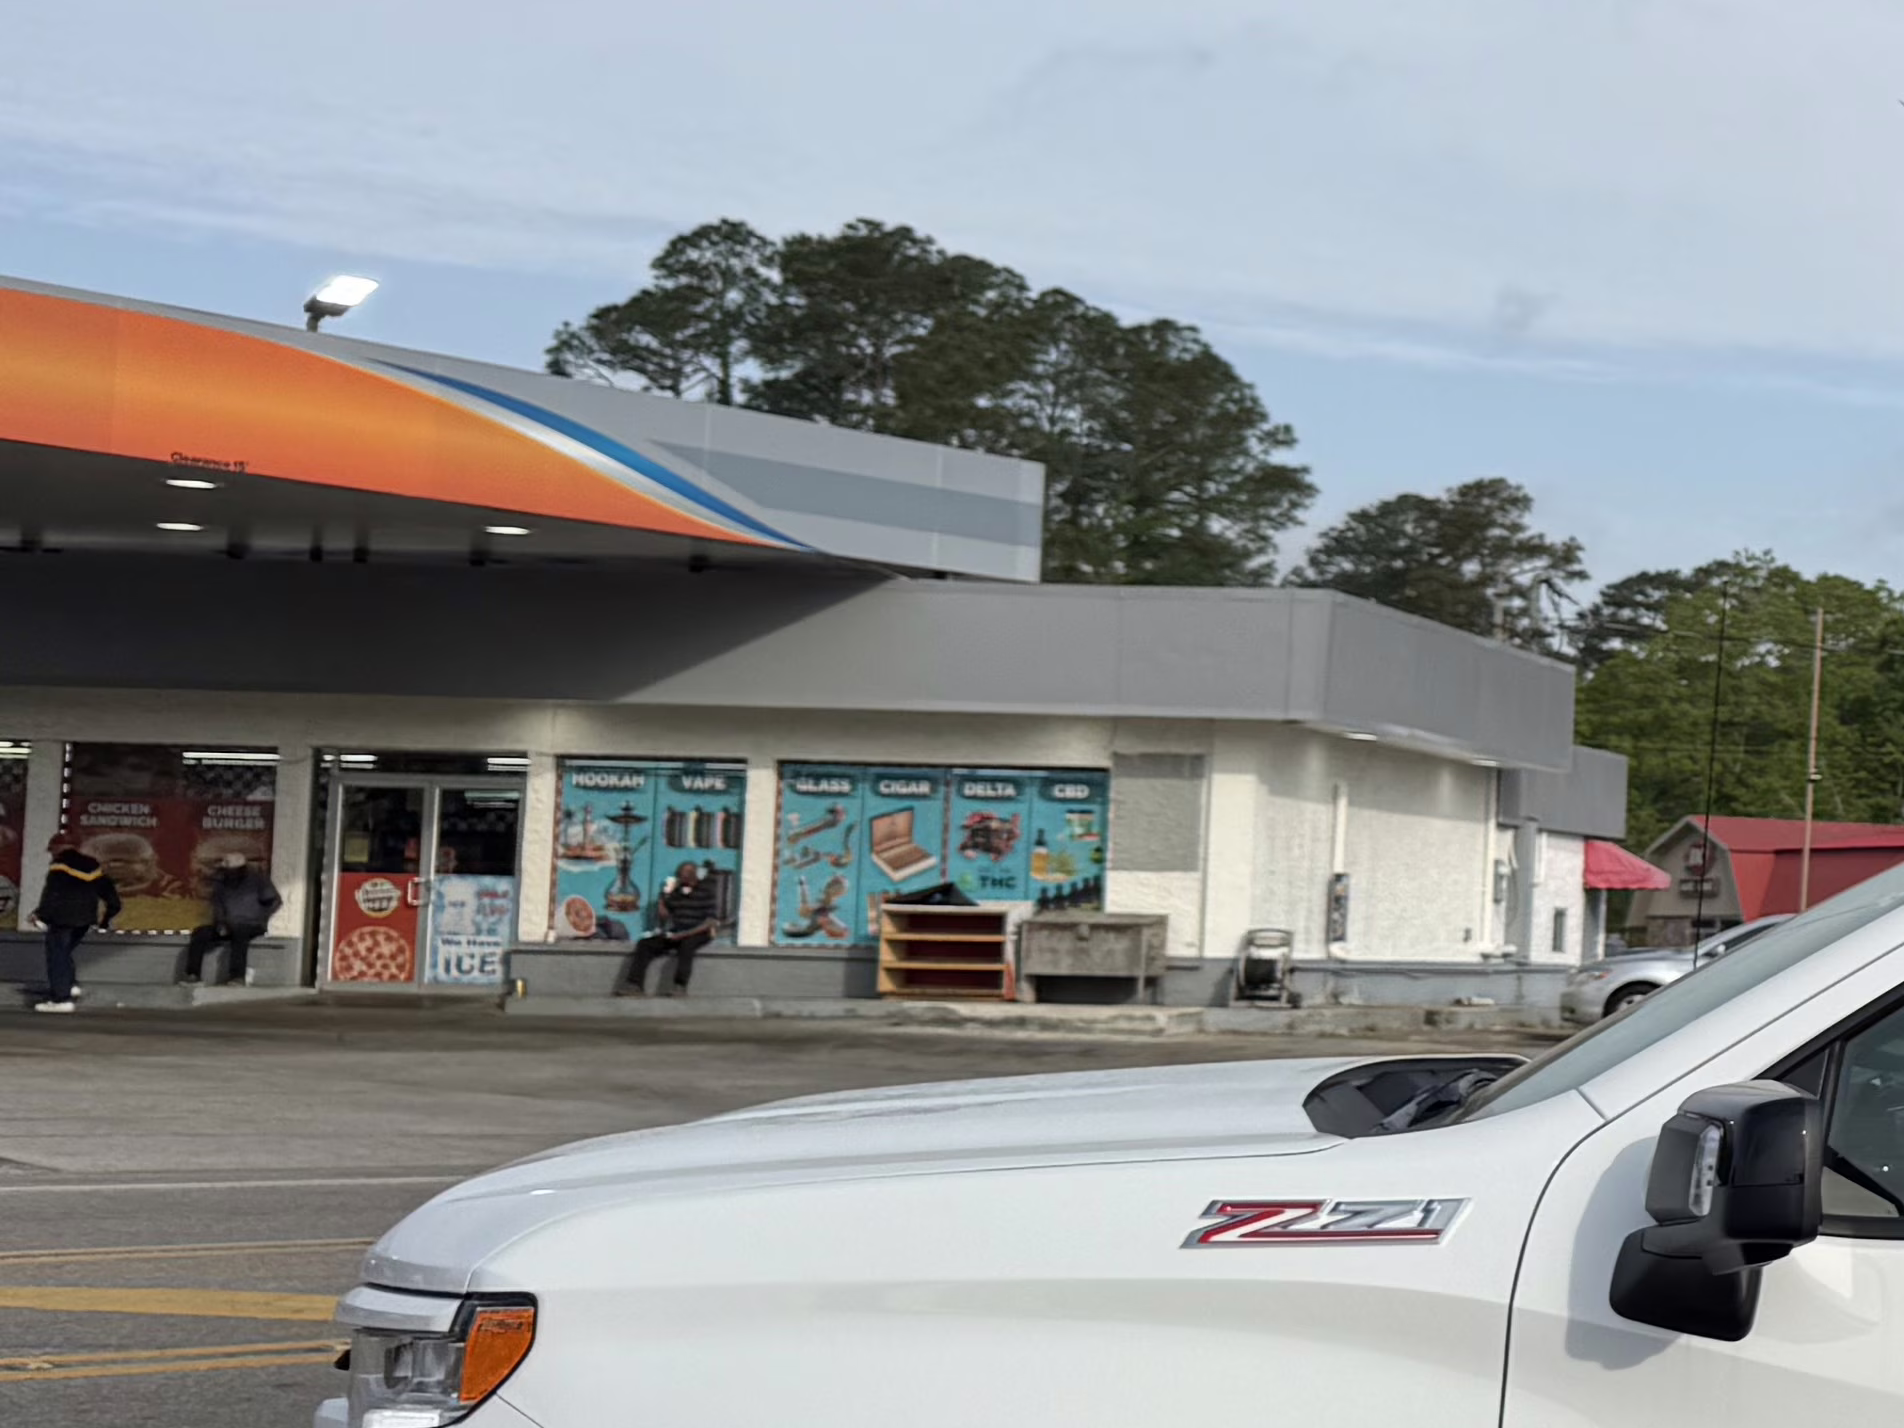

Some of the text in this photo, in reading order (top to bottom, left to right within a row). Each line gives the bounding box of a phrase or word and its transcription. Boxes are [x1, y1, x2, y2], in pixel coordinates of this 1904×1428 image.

[171, 452, 230, 471] Clearance
[571, 773, 645, 788] HOOKAH
[681, 775, 727, 789] VAPE
[796, 779, 852, 794] GLASS
[879, 780, 931, 795] CIGAR
[963, 782, 1017, 798] DELTA
[1053, 784, 1090, 800] CBD
[88, 803, 150, 815] CHICKEN
[207, 805, 261, 817] CHEESE
[80, 816, 160, 828] SANDWICH
[202, 818, 265, 830] BURGER
[979, 875, 1016, 889] THC
[441, 938, 502, 947] We Have
[444, 952, 497, 976] ICE
[1180, 1198, 1472, 1249] Z71
